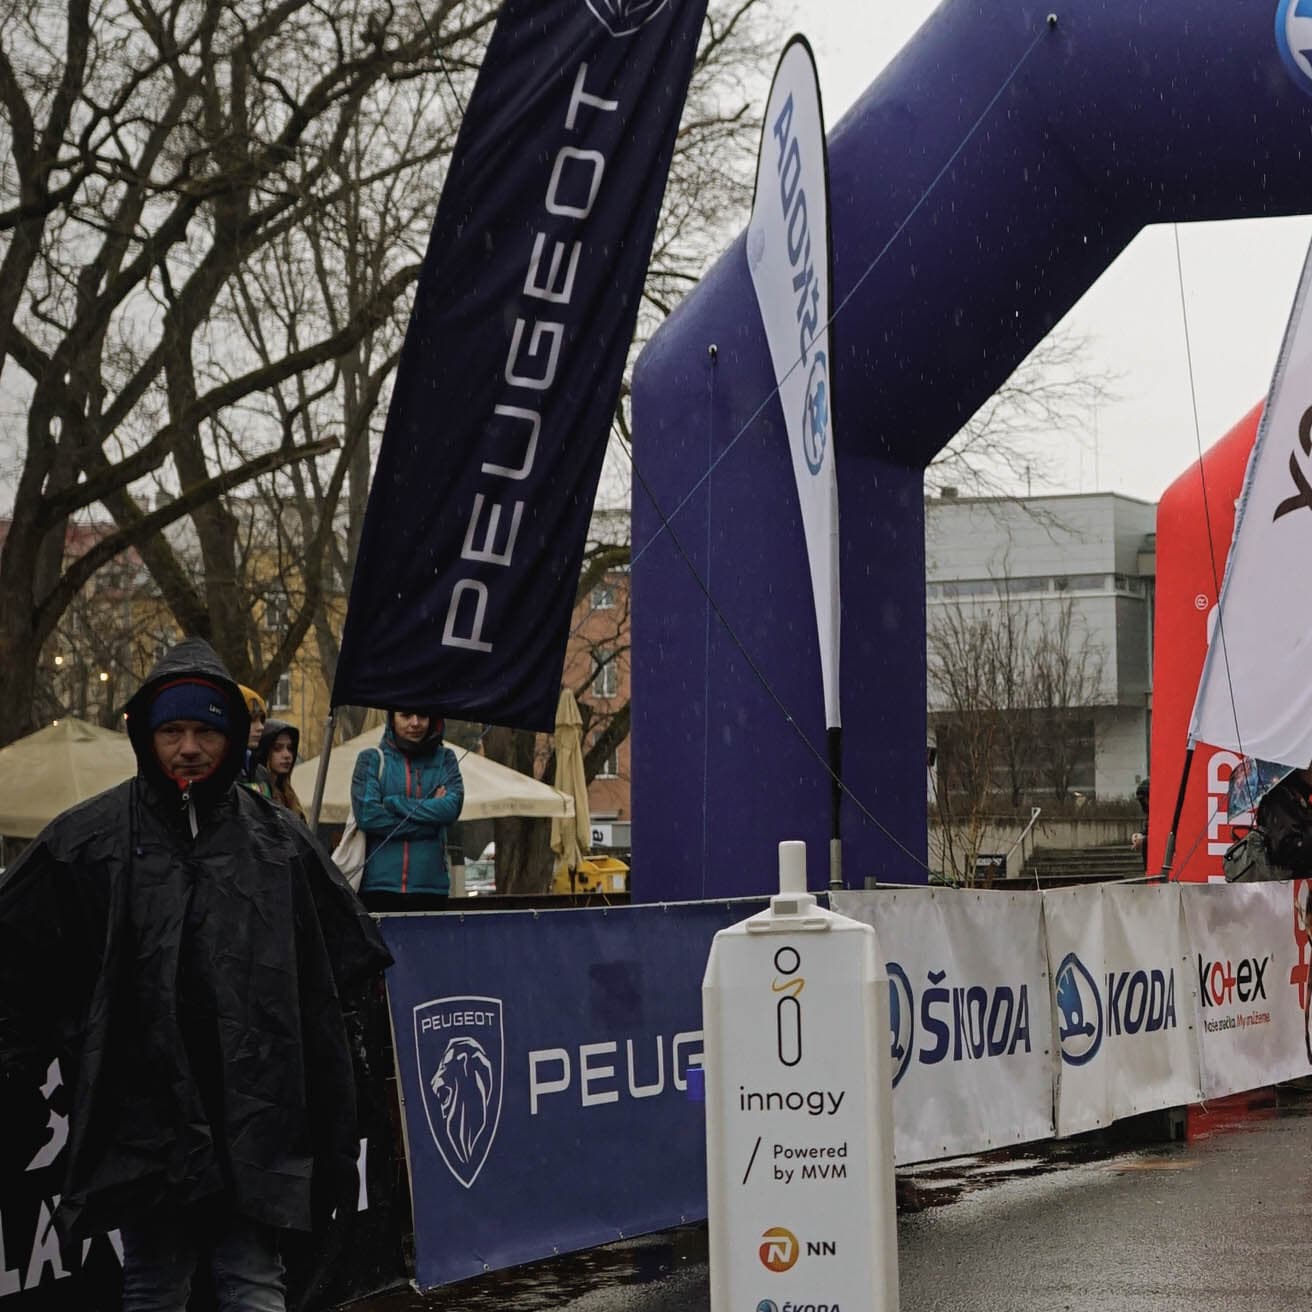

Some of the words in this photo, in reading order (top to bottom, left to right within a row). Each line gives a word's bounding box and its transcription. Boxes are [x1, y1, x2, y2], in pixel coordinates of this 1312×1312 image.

[441, 61, 618, 654] PEUGEOT
[1104, 967, 1177, 1038] KODA
[421, 1011, 495, 1033] PEUGEOT
[918, 969, 1032, 1066] ŠKODA
[740, 1086, 845, 1116] innogy
[773, 1142, 848, 1160] Powered
[773, 1166, 794, 1184] by
[801, 1164, 848, 1180] MVM
[807, 1241, 836, 1256] NN
